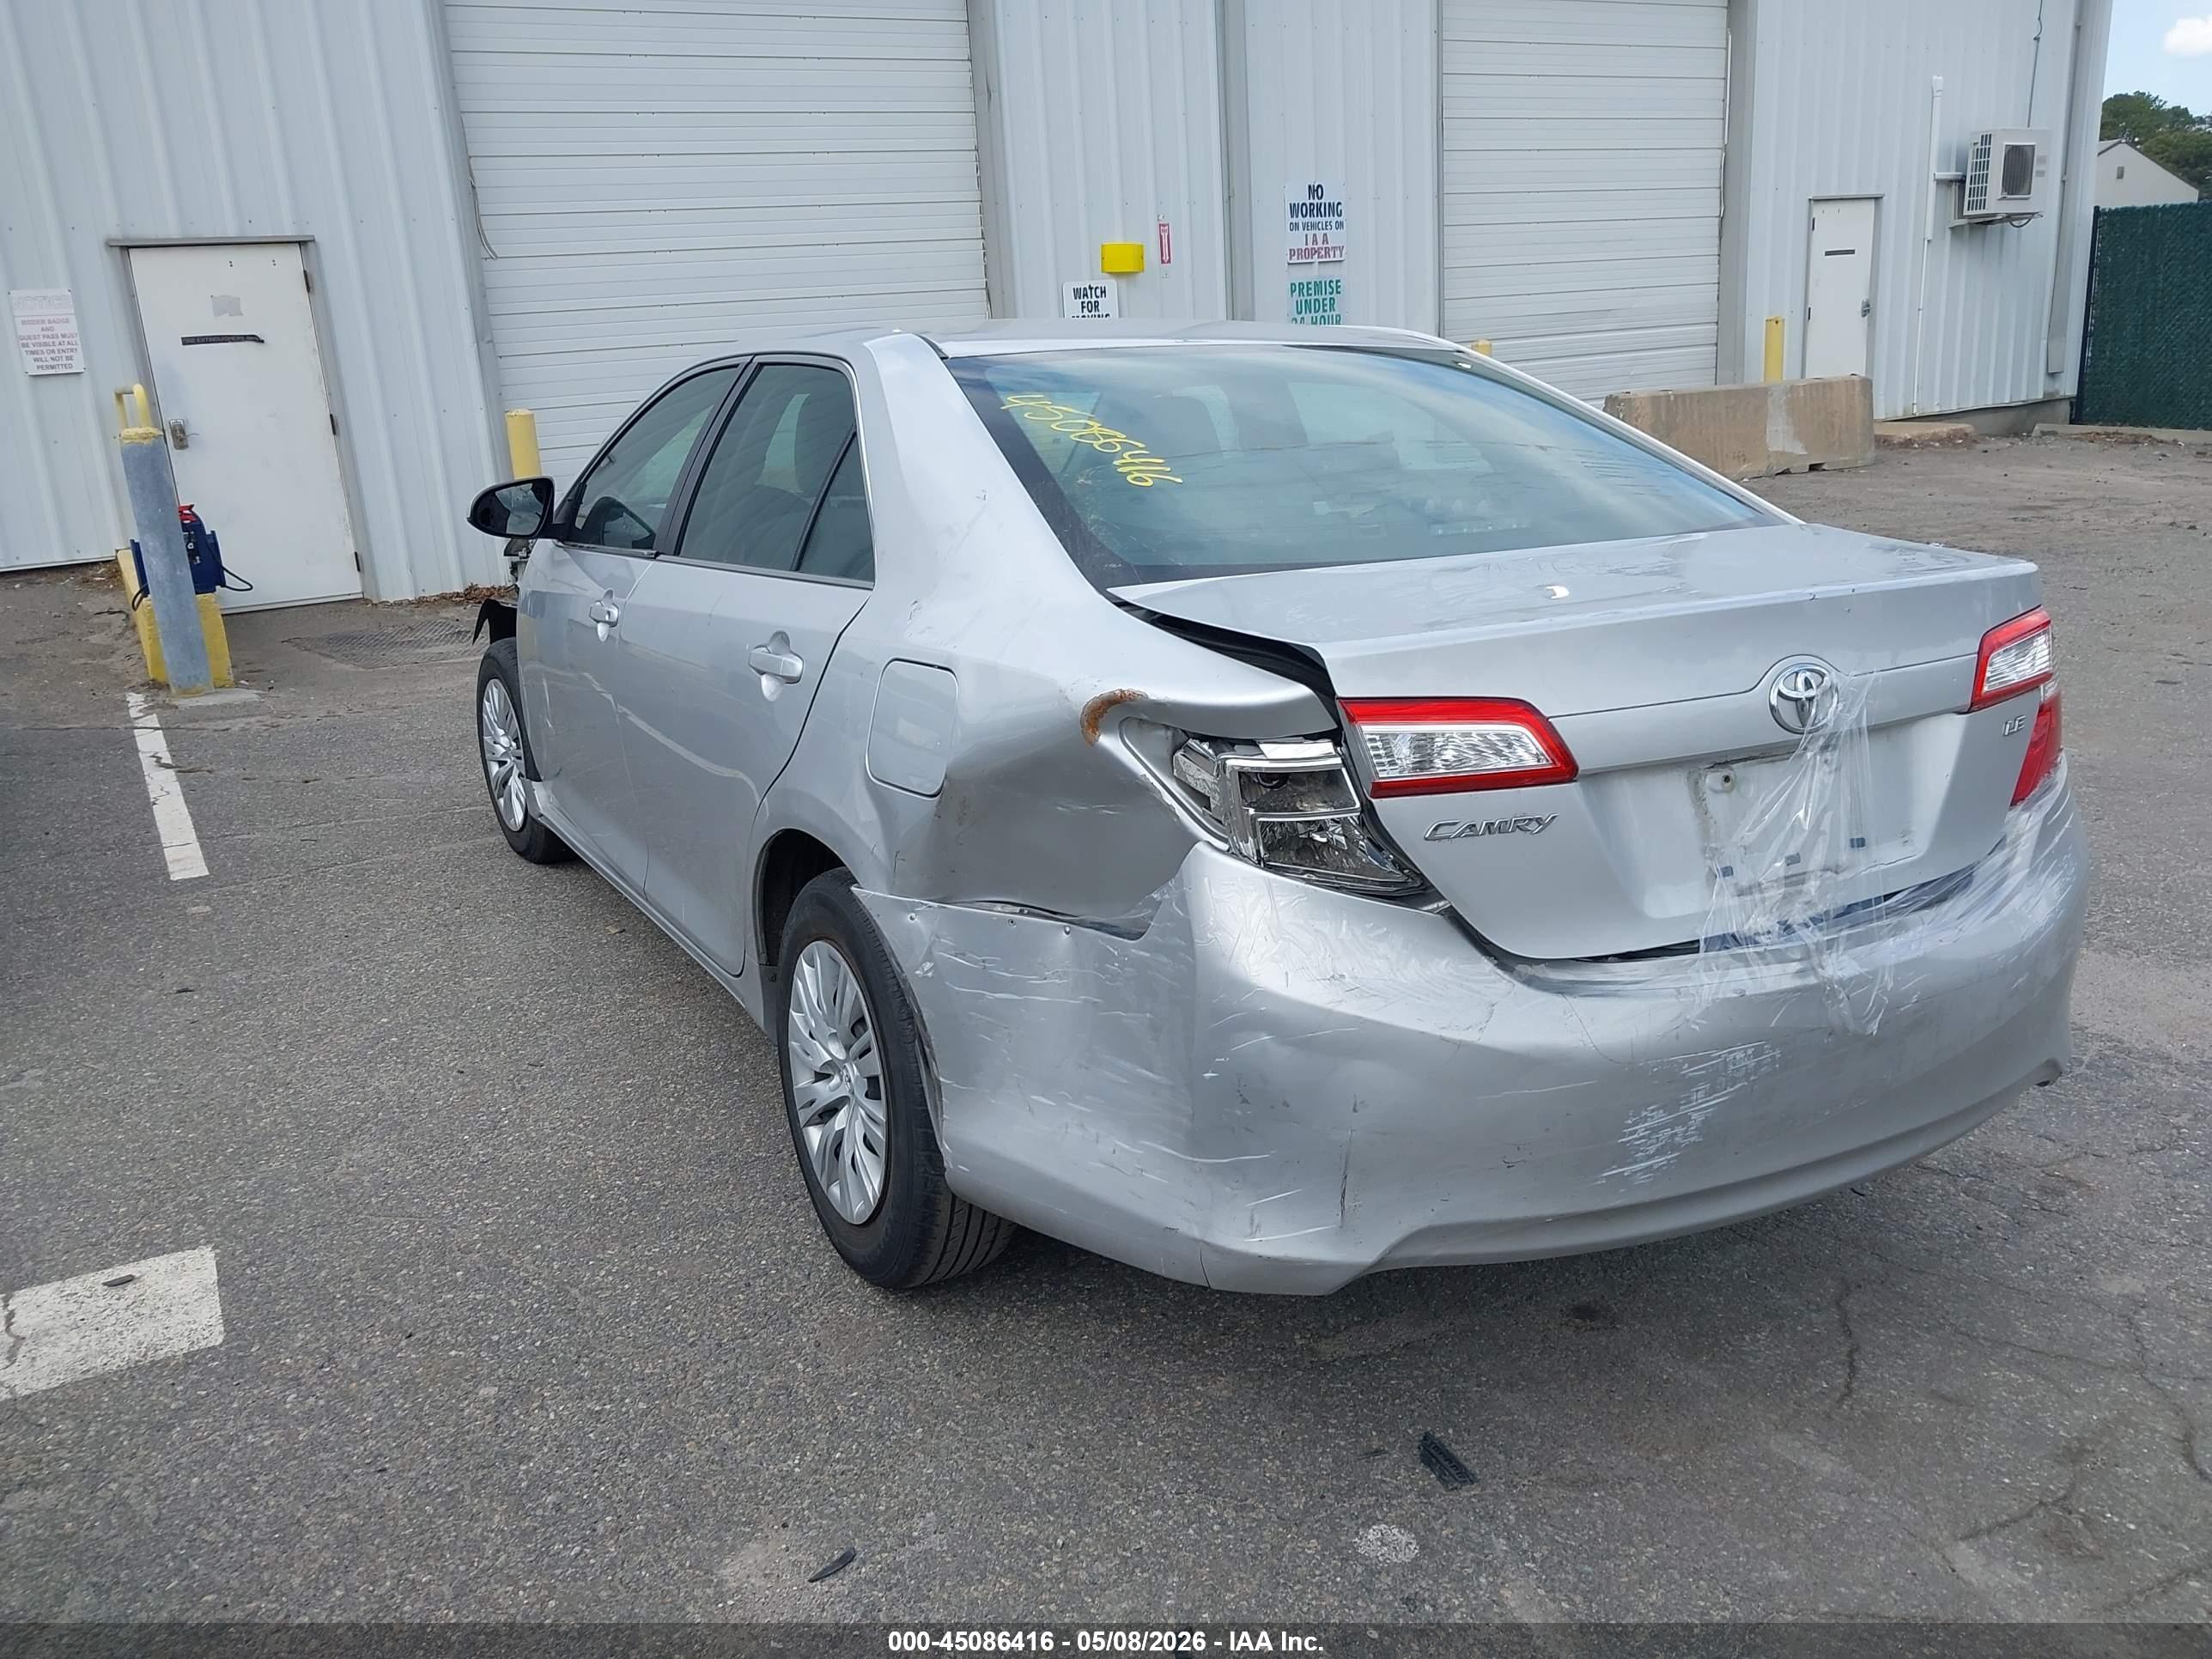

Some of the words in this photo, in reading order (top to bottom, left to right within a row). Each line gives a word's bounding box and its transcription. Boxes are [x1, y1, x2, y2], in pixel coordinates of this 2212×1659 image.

[1308, 184, 1324, 200] NO
[1289, 202, 1343, 218] WORKING
[1289, 222, 1300, 232] ON
[1302, 221, 1333, 231] VEHICLES
[1335, 220, 1345, 230] ON
[1289, 246, 1345, 261] PROPERTY
[1073, 285, 1107, 300] WATCH
[1290, 279, 1341, 298] PREMISE
[1080, 301, 1100, 313] FOR
[1296, 297, 1335, 315] UNDER
[1000, 394, 1184, 488] 45086416
[2002, 714, 2027, 737] LE
[1424, 812, 1559, 842] CAMRY
